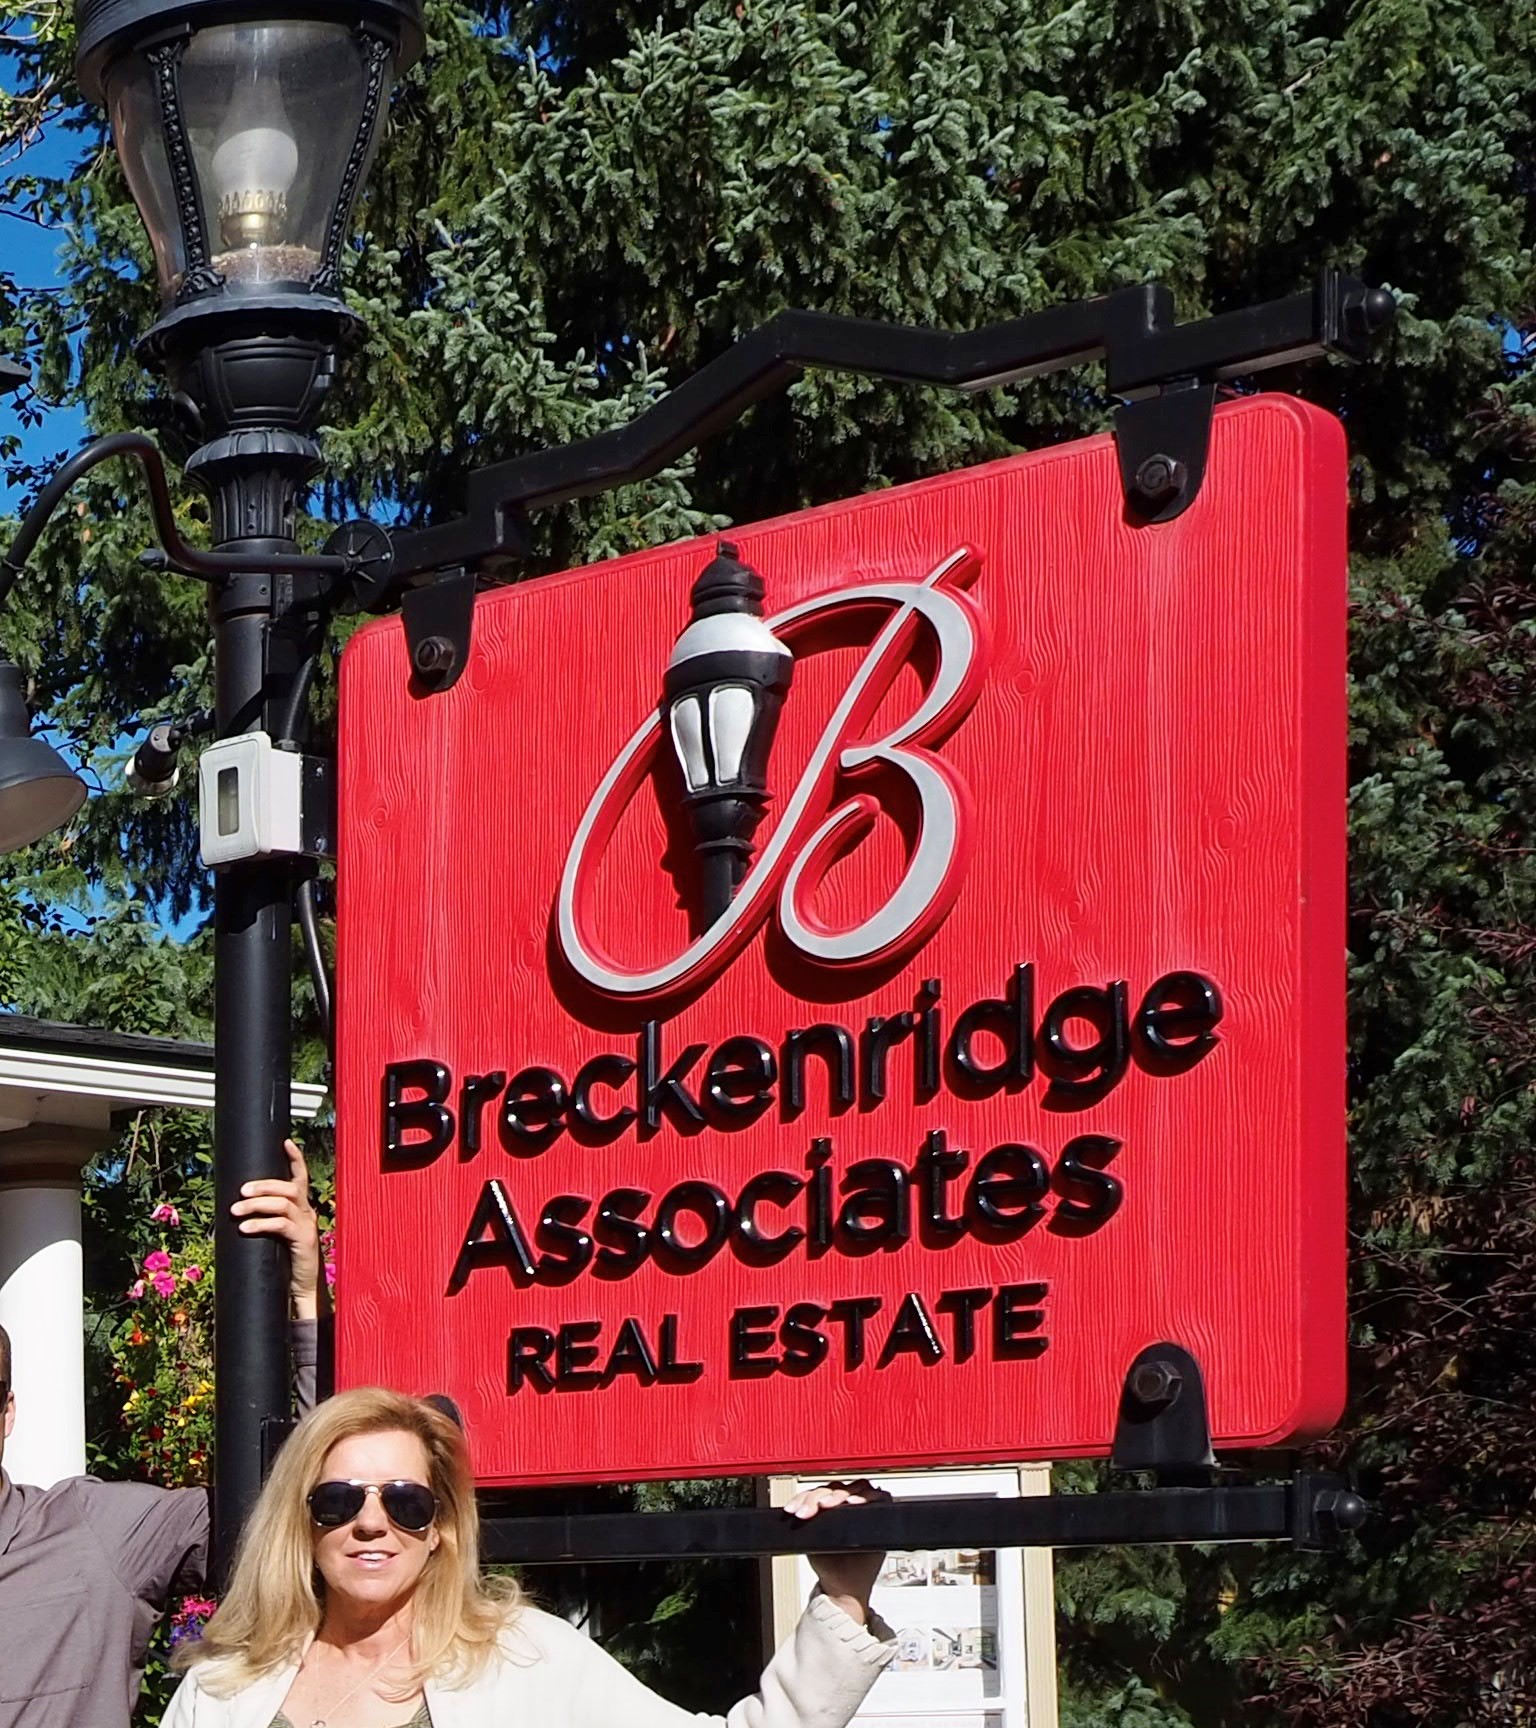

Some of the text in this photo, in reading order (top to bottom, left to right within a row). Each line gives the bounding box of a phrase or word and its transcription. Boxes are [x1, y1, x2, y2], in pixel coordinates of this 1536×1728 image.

[379, 964, 1222, 1170] Breckenridge
[447, 1130, 1124, 1295] Associates
[507, 1282, 1048, 1392] REAL ESTATE
